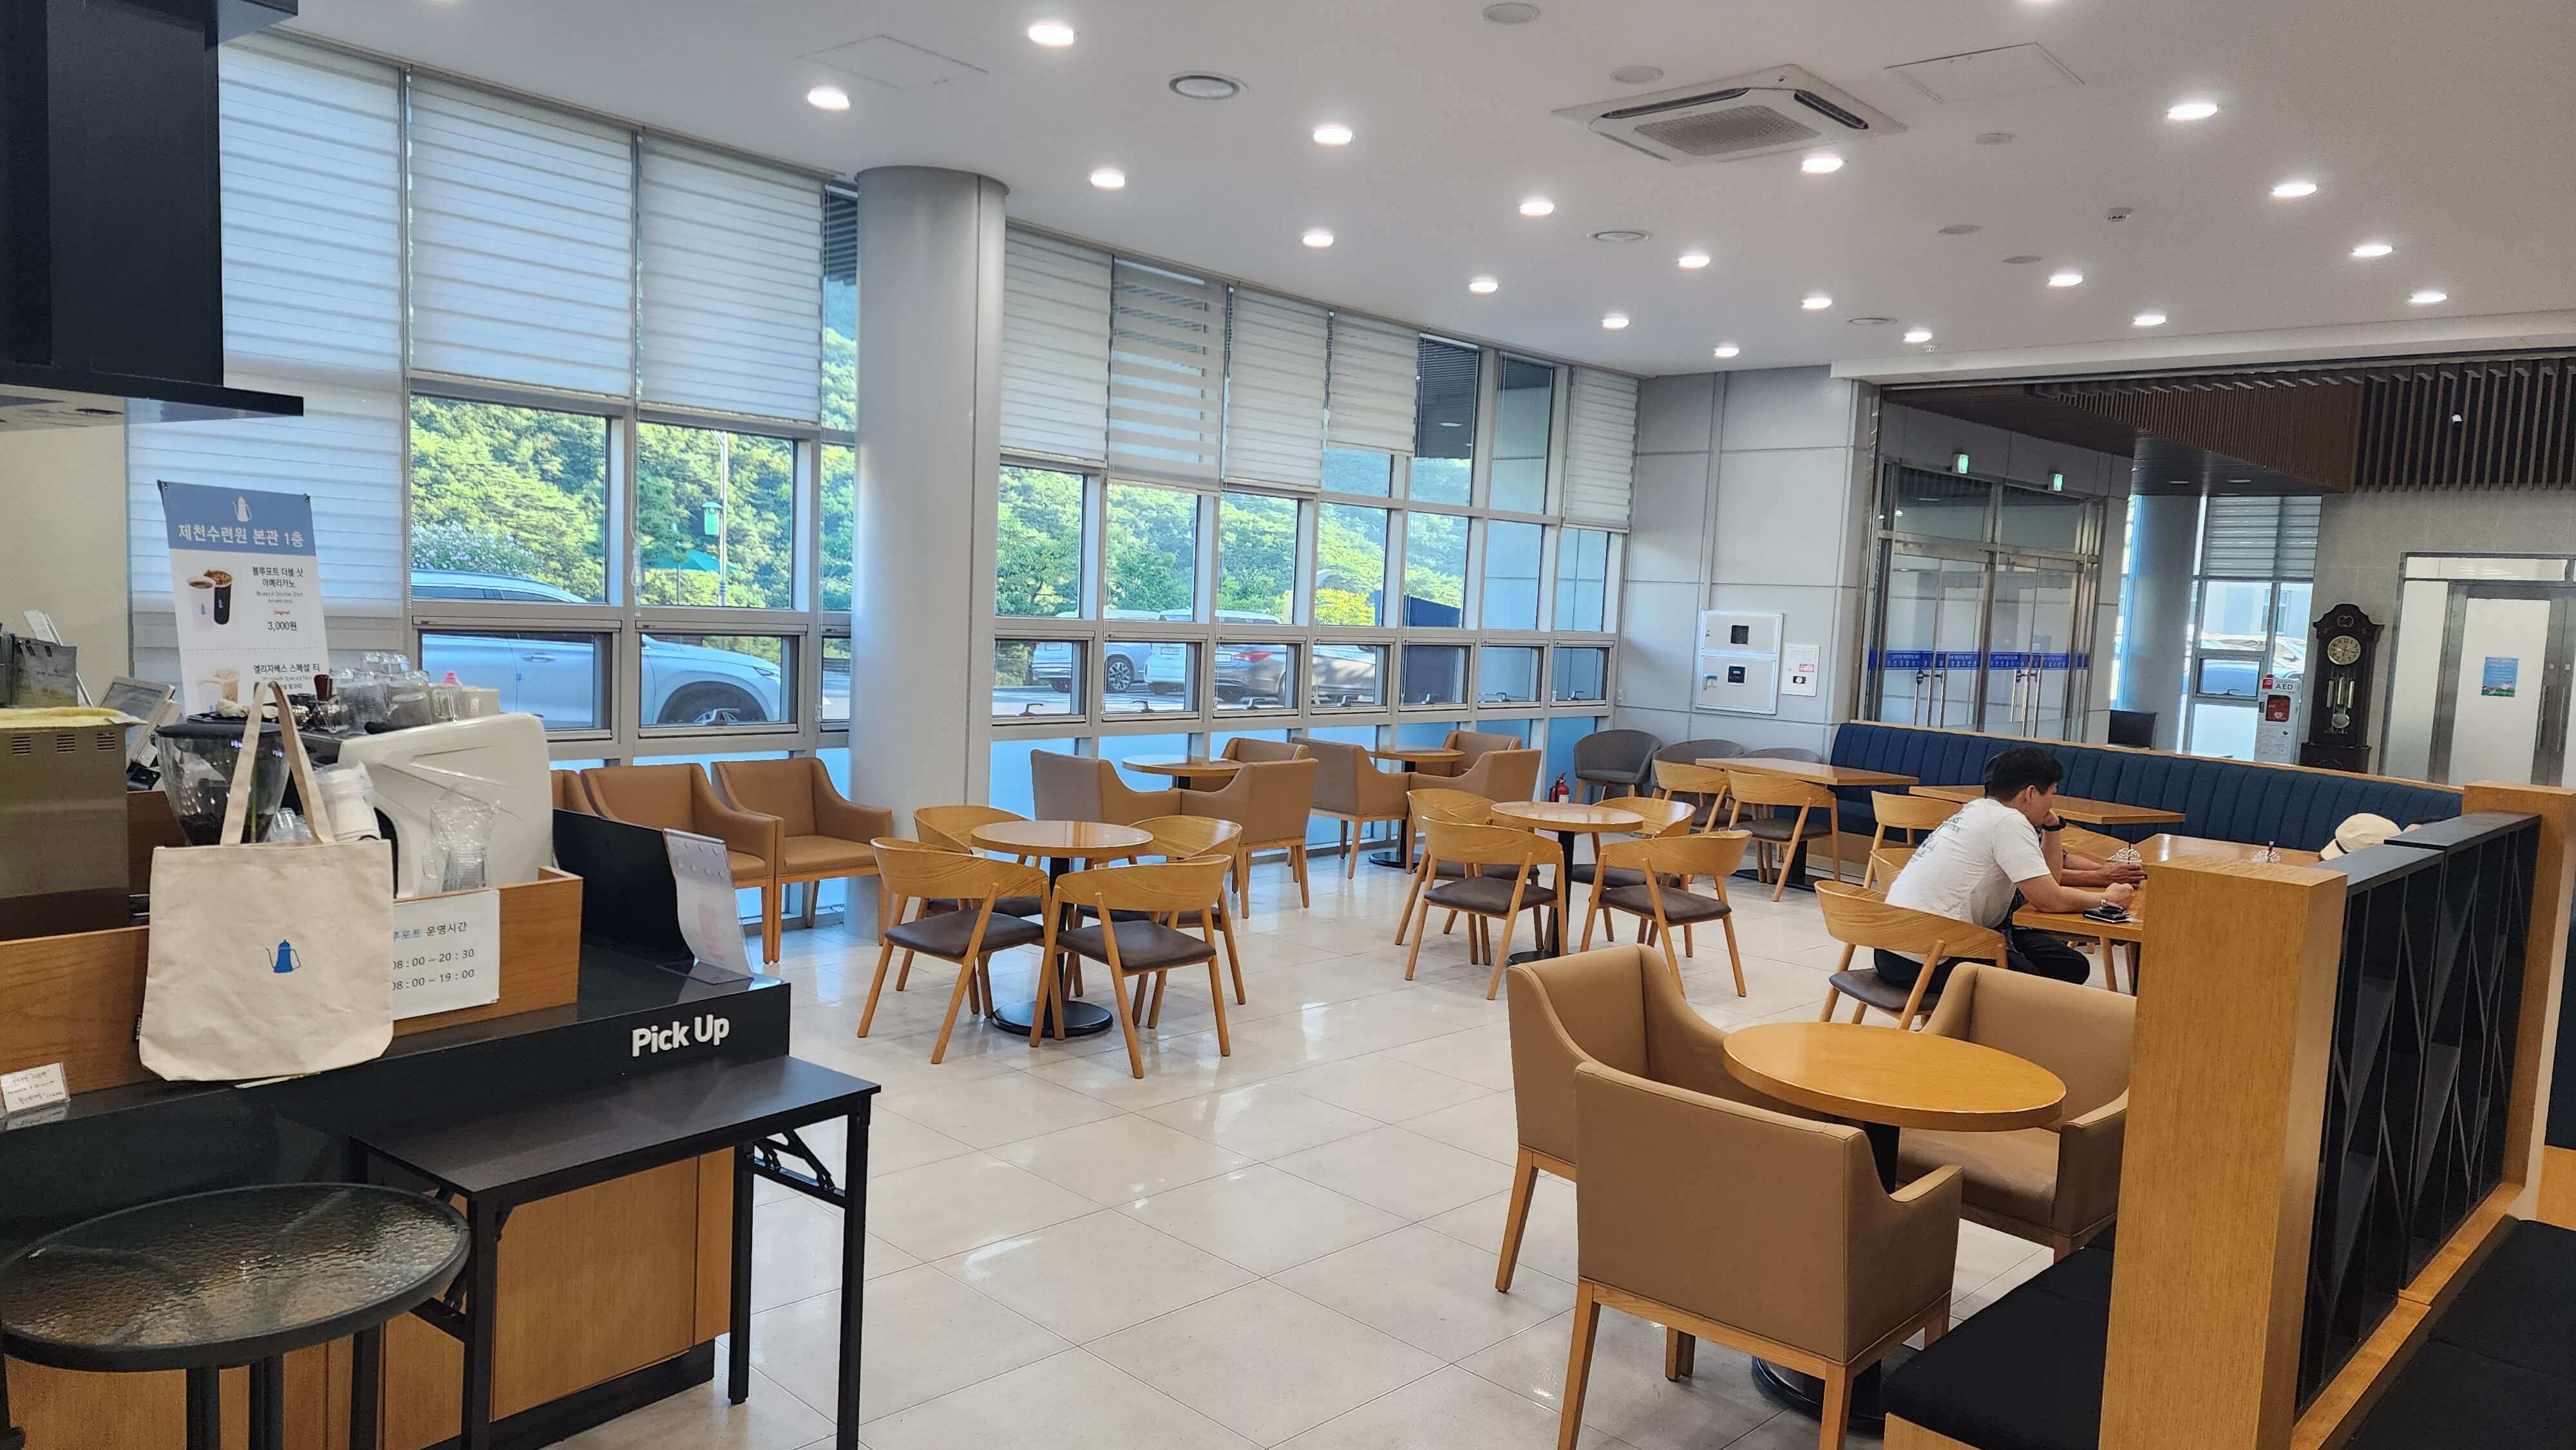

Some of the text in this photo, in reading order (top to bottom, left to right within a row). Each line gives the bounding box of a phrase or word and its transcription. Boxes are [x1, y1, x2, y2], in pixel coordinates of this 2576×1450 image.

[178, 523, 304, 547] 제천수련원 본관 1층
[281, 567, 294, 578] 더블
[262, 578, 296, 588] 아메리카노
[268, 620, 298, 632] 3,000원
[312, 663, 321, 672] 티
[2275, 683, 2294, 691] AED
[426, 921, 468, 936] 운영시간
[632, 1014, 730, 1057] Pick Up
